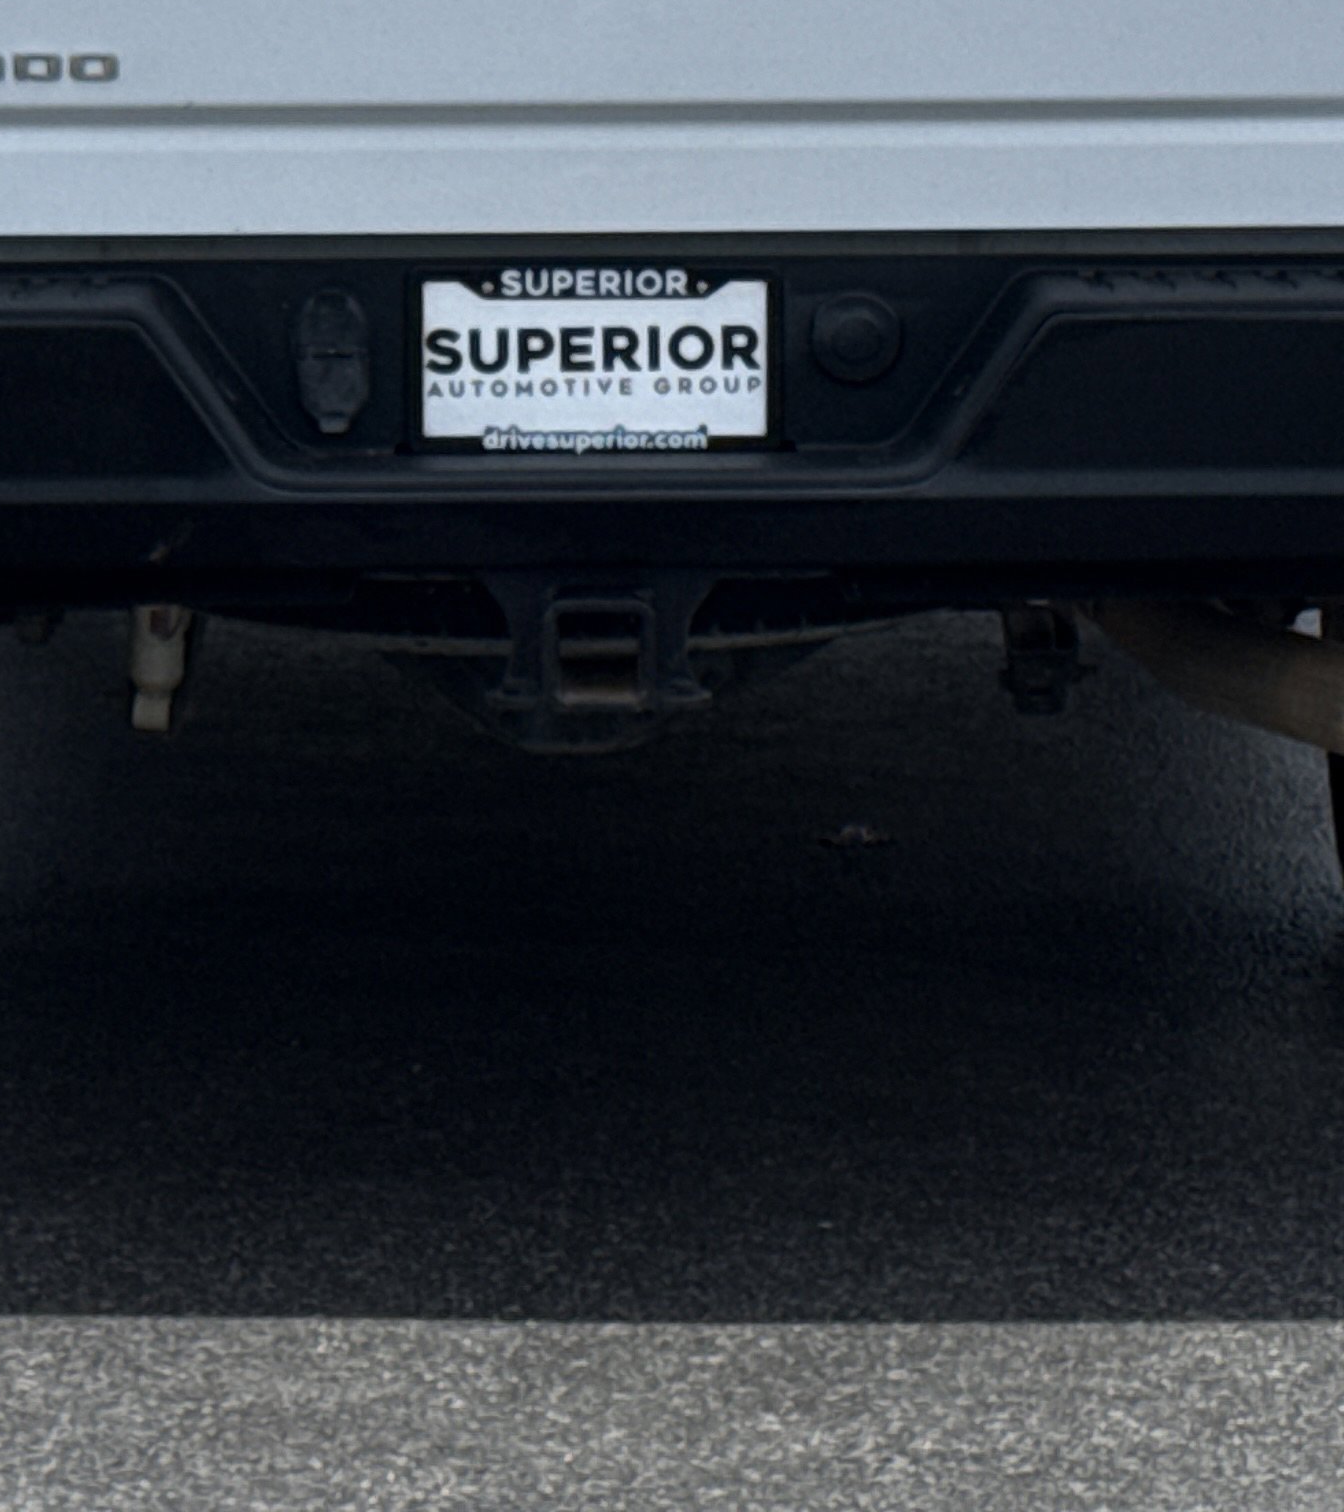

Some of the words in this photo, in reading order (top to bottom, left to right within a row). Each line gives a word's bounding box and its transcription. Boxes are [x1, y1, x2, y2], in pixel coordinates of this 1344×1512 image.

[500, 268, 688, 297] SUPERIOR
[425, 324, 761, 375] SUPERIOR
[427, 376, 633, 398] AUTOMOTIVE
[653, 374, 762, 396] GROUP
[483, 426, 708, 455] drivesuperior.com
